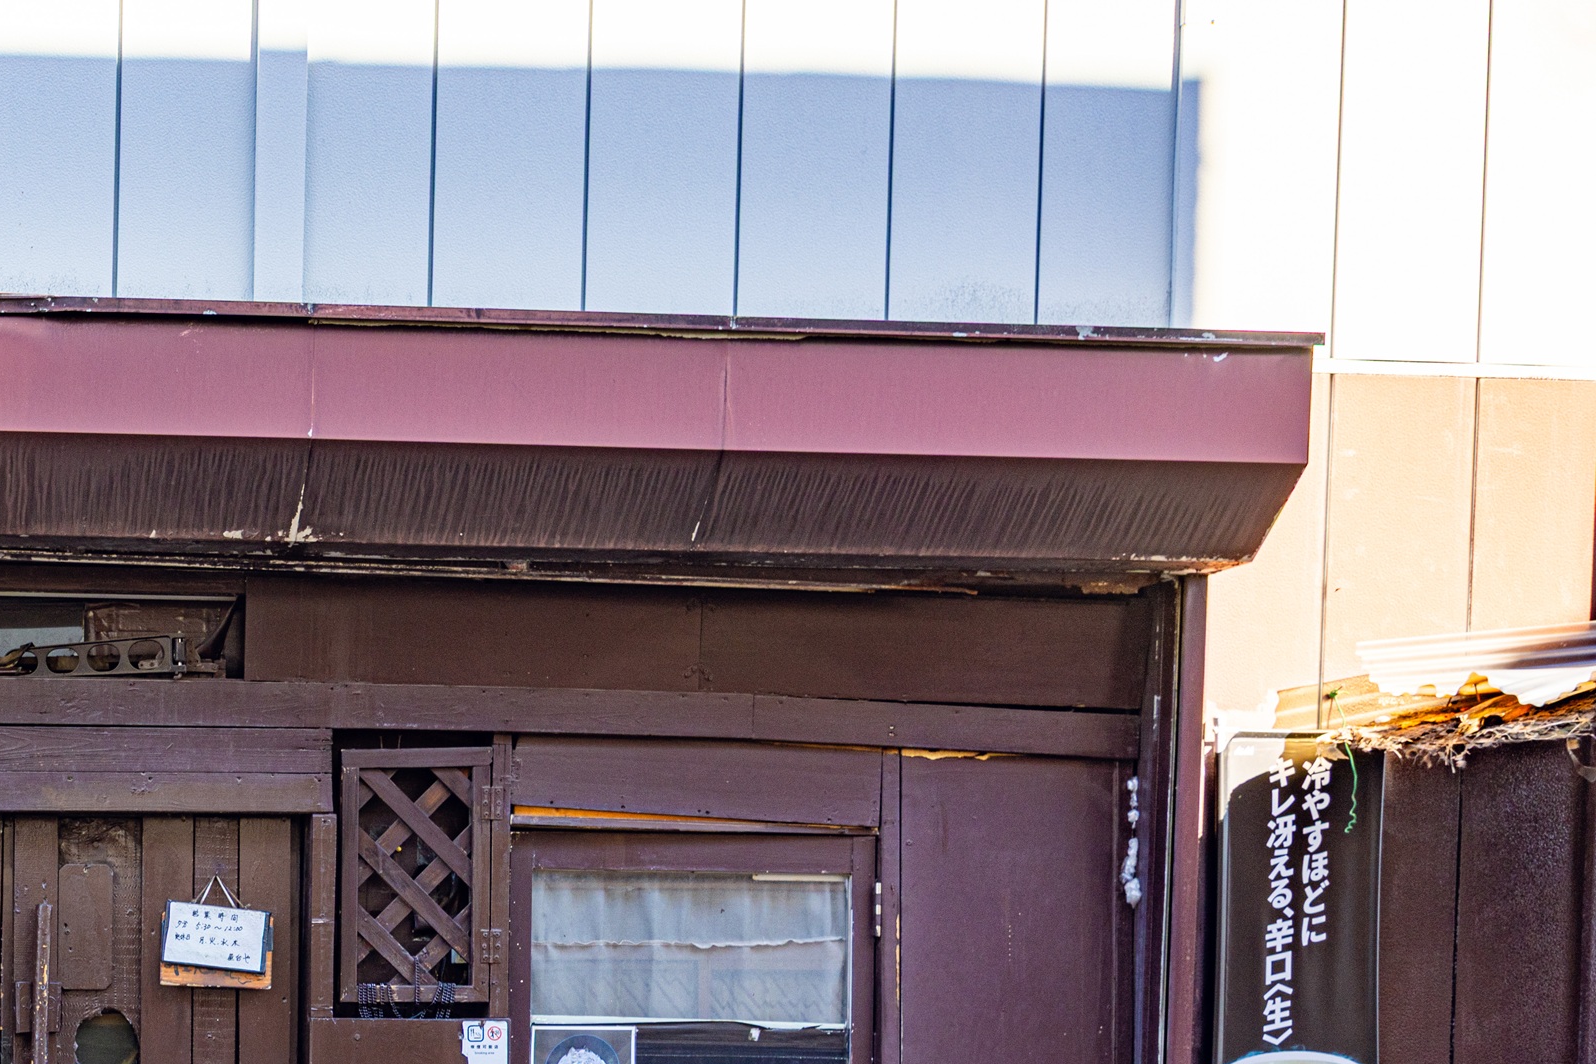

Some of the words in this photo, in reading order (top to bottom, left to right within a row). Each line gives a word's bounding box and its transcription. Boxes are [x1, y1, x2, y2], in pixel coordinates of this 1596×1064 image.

[1301, 756, 1332, 946] 冷やすほどに
